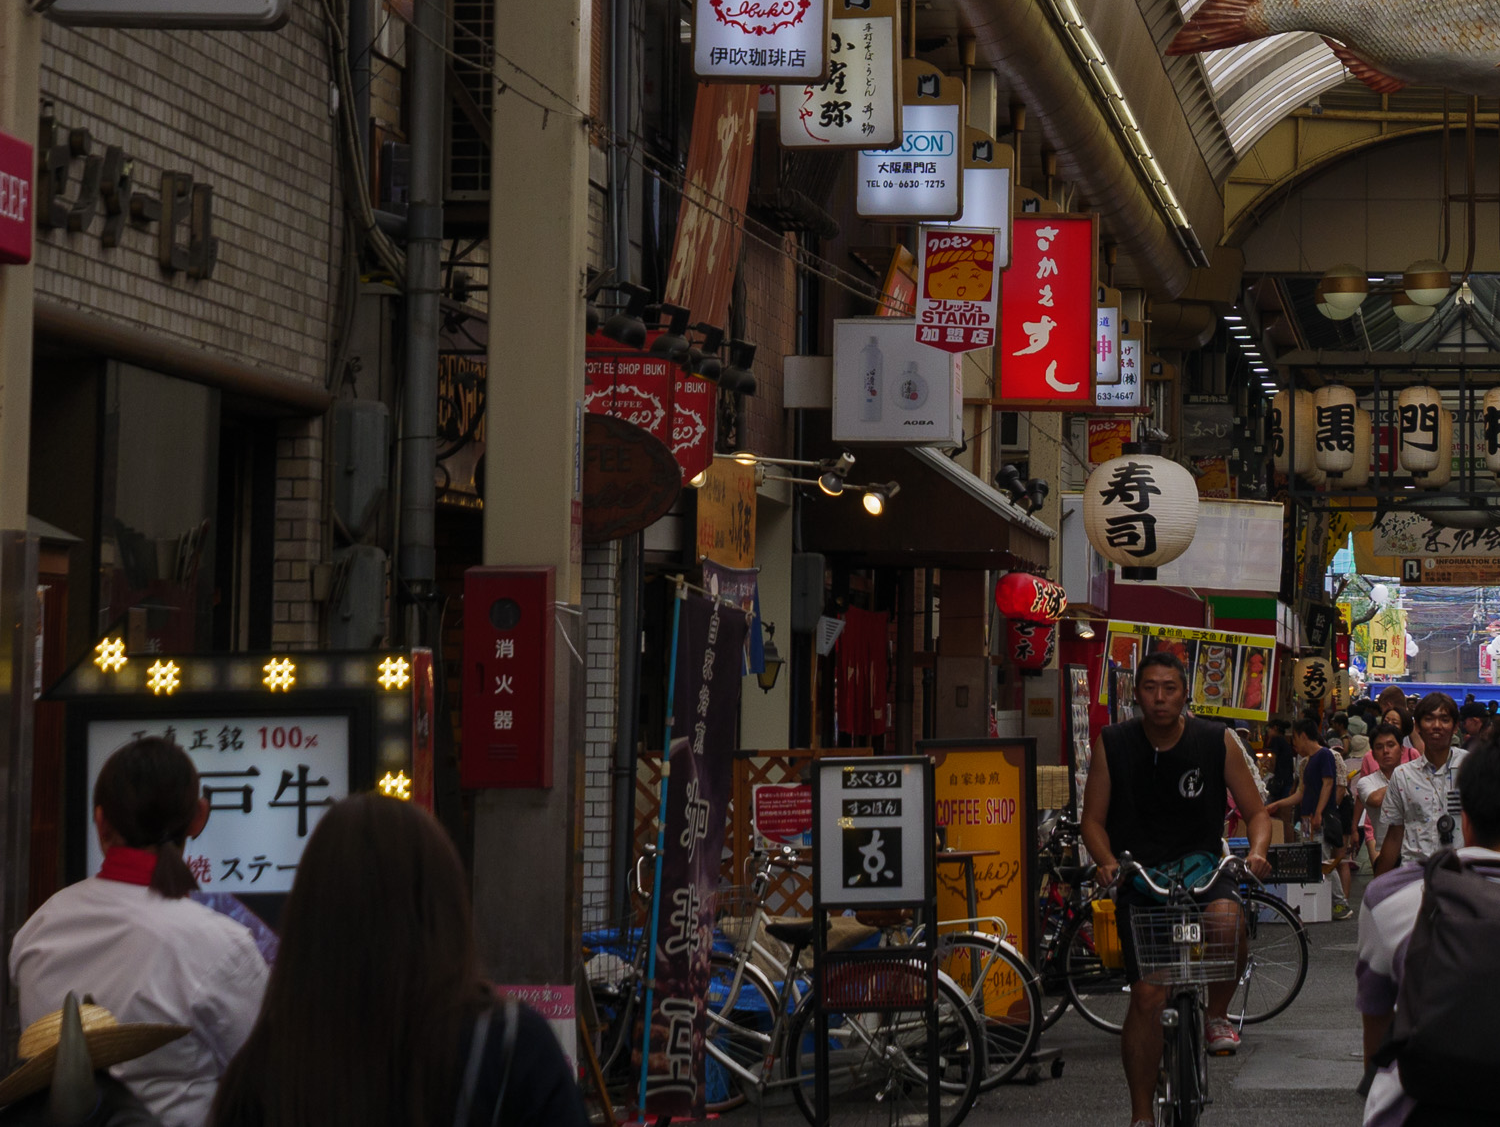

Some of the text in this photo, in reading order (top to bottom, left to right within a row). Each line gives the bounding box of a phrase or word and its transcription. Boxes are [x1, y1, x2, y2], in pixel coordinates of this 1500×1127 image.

[710, 47, 806, 67] 伊吹珈琲店
[878, 162, 937, 174] 大阪黒門店
[867, 180, 945, 188] TEL 06-6630-7275
[928, 236, 972, 250] クロモン
[928, 300, 982, 312] フレッシュ
[922, 311, 990, 325] STAMP
[921, 327, 989, 343] 加盟店
[618, 364, 640, 375] SHOP
[643, 364, 666, 375] IBUKI
[684, 382, 706, 393] IBUKI
[601, 400, 643, 408] COFFEE
[1100, 462, 1161, 557] 寿司
[494, 637, 516, 731] 消火器
[258, 726, 319, 750] 100%
[847, 772, 898, 787] ふぐちり
[848, 802, 897, 816] すっぽん
[935, 797, 1016, 826] COFFEE SHOP
